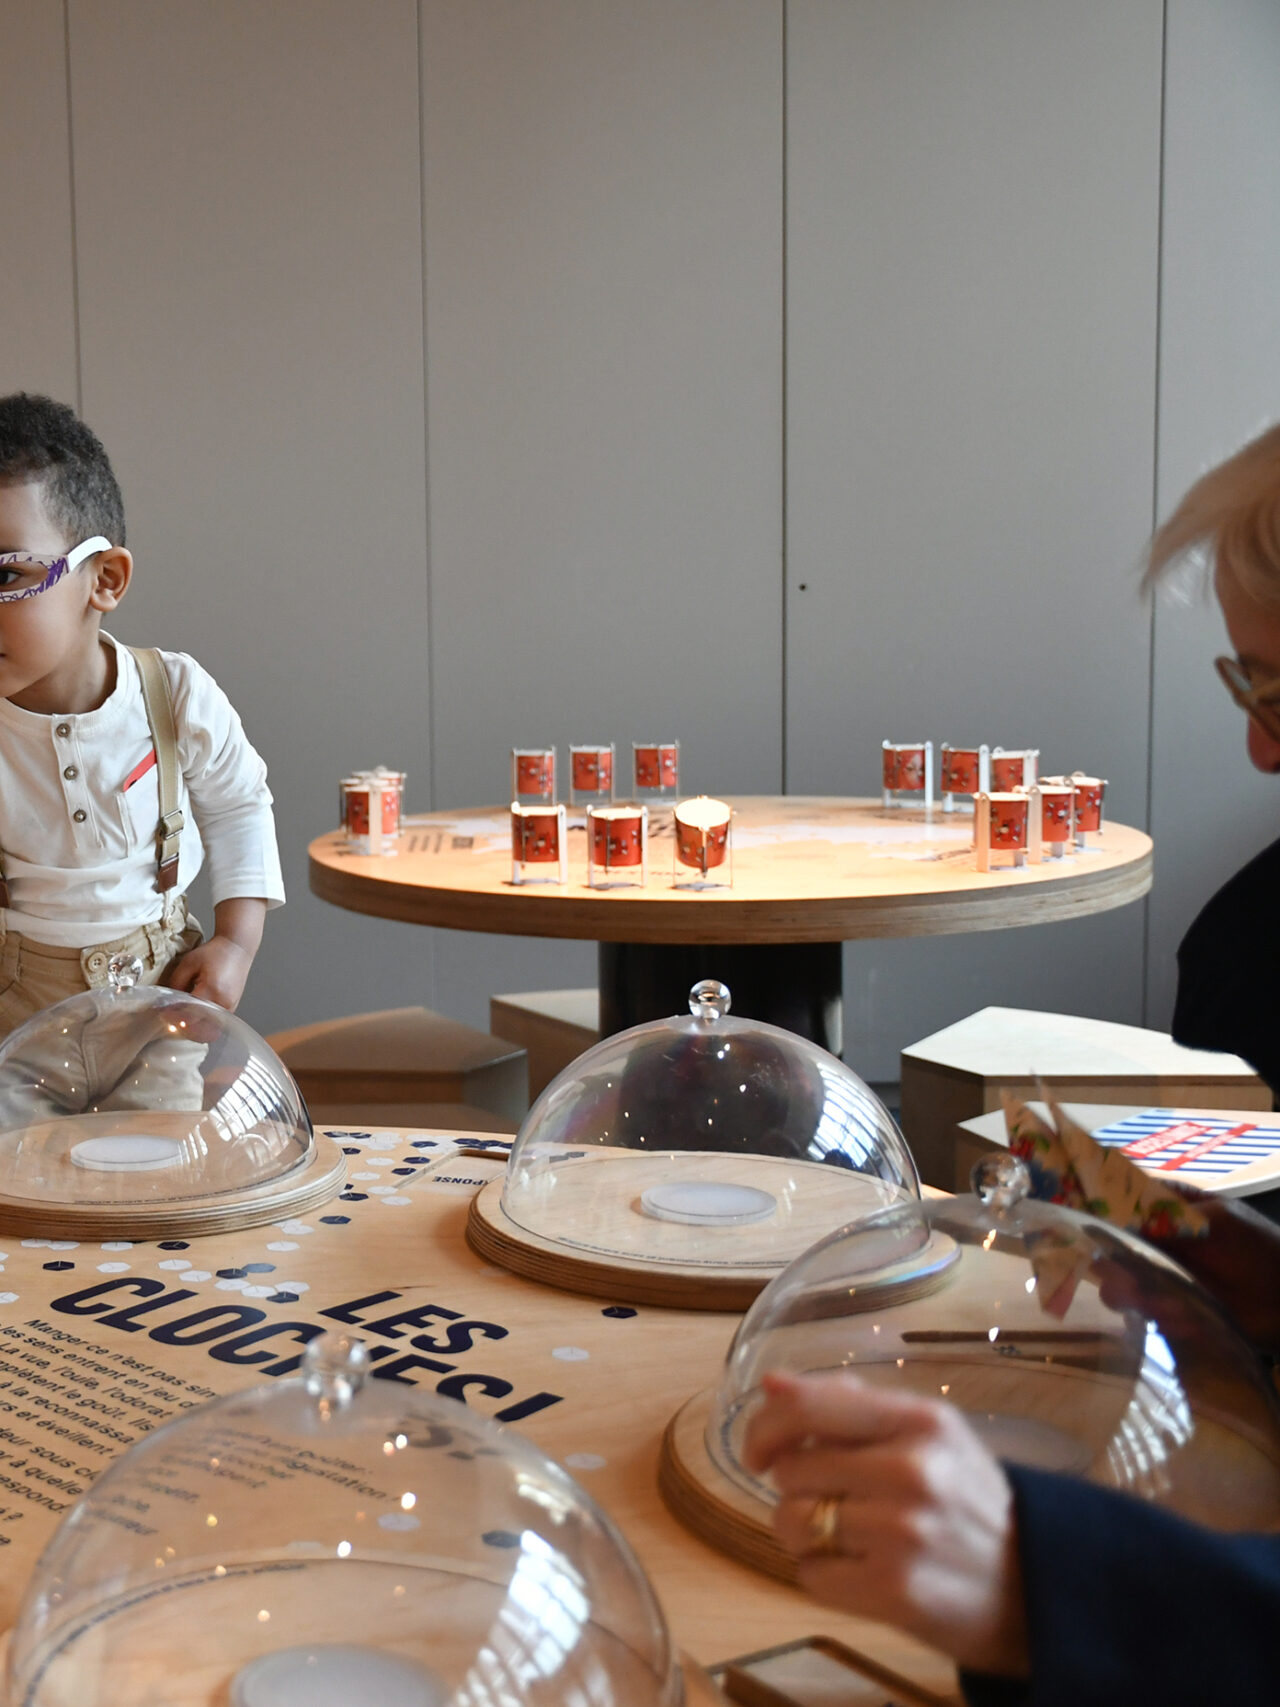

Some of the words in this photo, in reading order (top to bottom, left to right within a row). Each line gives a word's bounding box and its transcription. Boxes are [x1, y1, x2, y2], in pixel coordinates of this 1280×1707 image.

[317, 1290, 509, 1354] LES
[23, 1319, 89, 1346] Manger
[86, 1344, 110, 1355] ce
[107, 1353, 153, 1372] n'est
[145, 1370, 187, 1386] pas
[23, 1335, 65, 1355] sens
[62, 1352, 128, 1380] entrent
[124, 1378, 150, 1389] en
[142, 1387, 180, 1402] jeu
[20, 1352, 51, 1369] vue,
[101, 1386, 173, 1418] l'odorat
[60, 1388, 82, 1400] le
[75, 1398, 128, 1420] goût.
[128, 1418, 156, 1432] Ils
[9, 1386, 30, 1397] la
[26, 1395, 135, 1444] reconnaissa
[16, 1411, 41, 1421] et
[36, 1419, 115, 1455] éveillent
[9, 1458, 28, 1468] à
[24, 1466, 84, 1496] quelle
[29, 1446, 76, 1468] sous
[2, 1511, 24, 1521] ?
